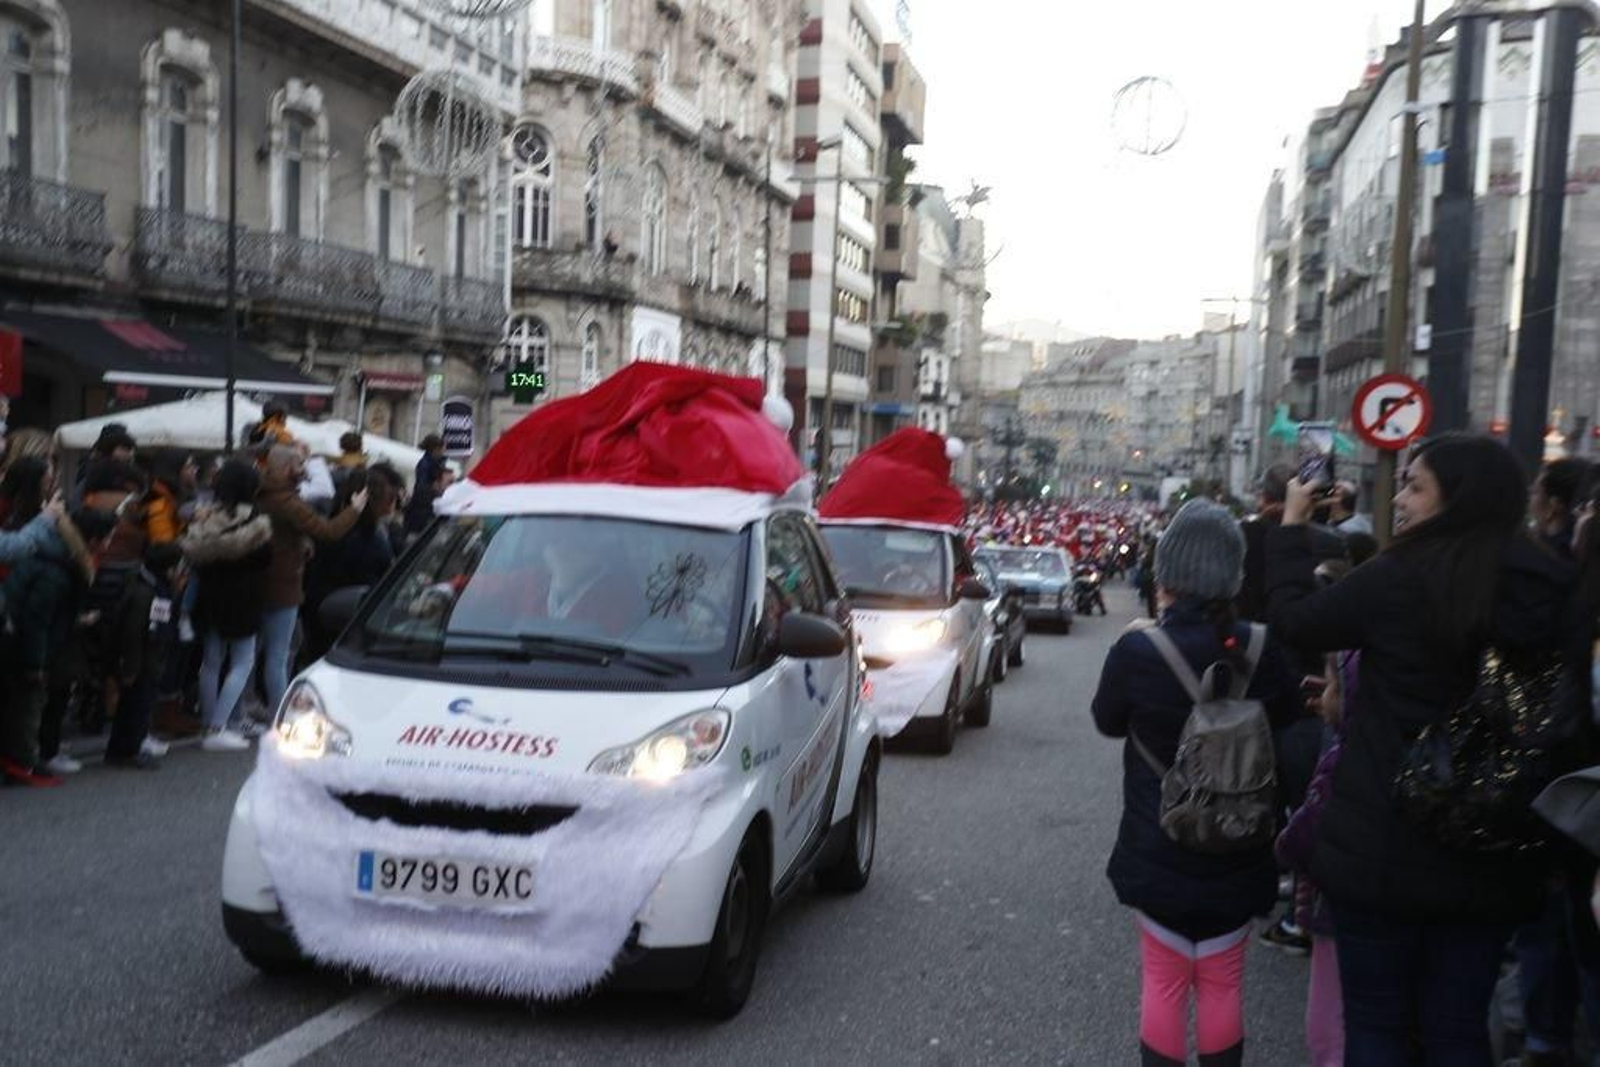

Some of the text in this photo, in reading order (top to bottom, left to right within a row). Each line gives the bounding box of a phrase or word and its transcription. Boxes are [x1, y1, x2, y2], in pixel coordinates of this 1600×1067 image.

[511, 373, 543, 387] 17:41
[380, 857, 533, 900] 9799 GXC
